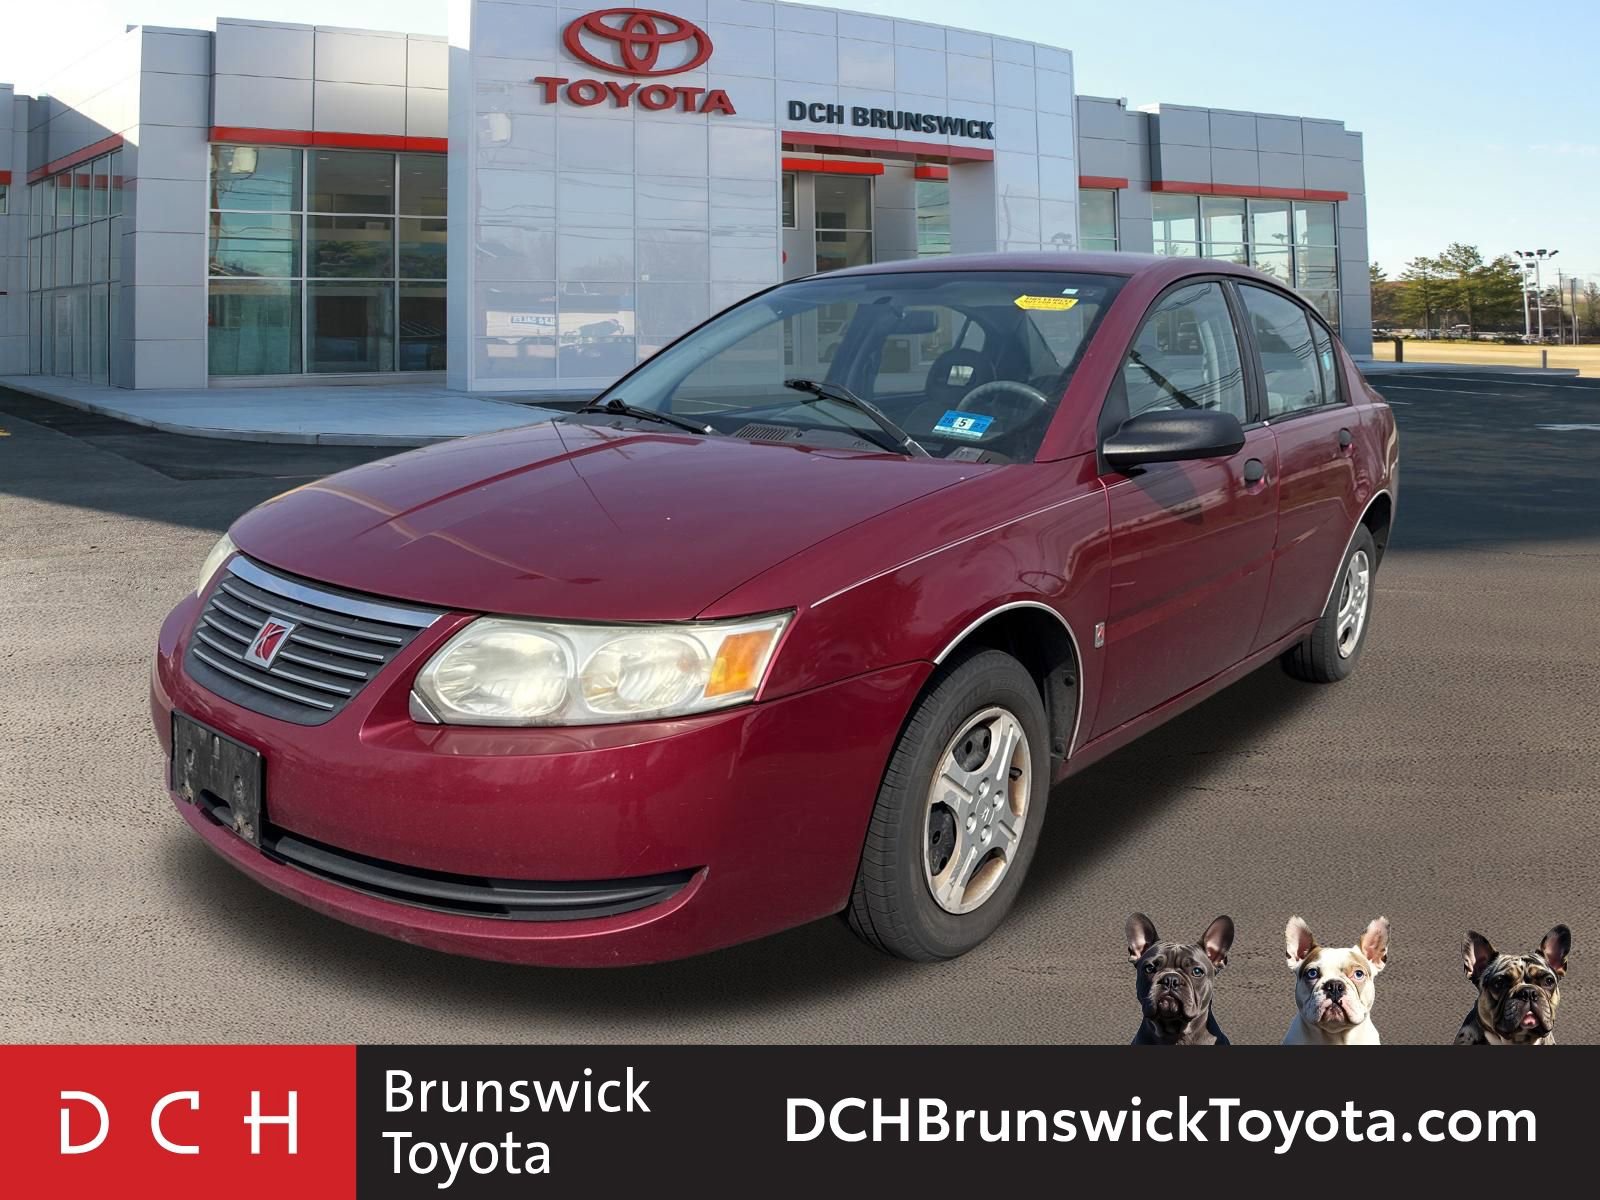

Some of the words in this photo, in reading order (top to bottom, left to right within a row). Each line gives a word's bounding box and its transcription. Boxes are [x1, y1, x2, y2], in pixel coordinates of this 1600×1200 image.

[534, 76, 736, 115] TOYOTA
[788, 100, 844, 126] DCH
[852, 107, 995, 141] BRUNSWICK
[958, 418, 968, 427] 5
